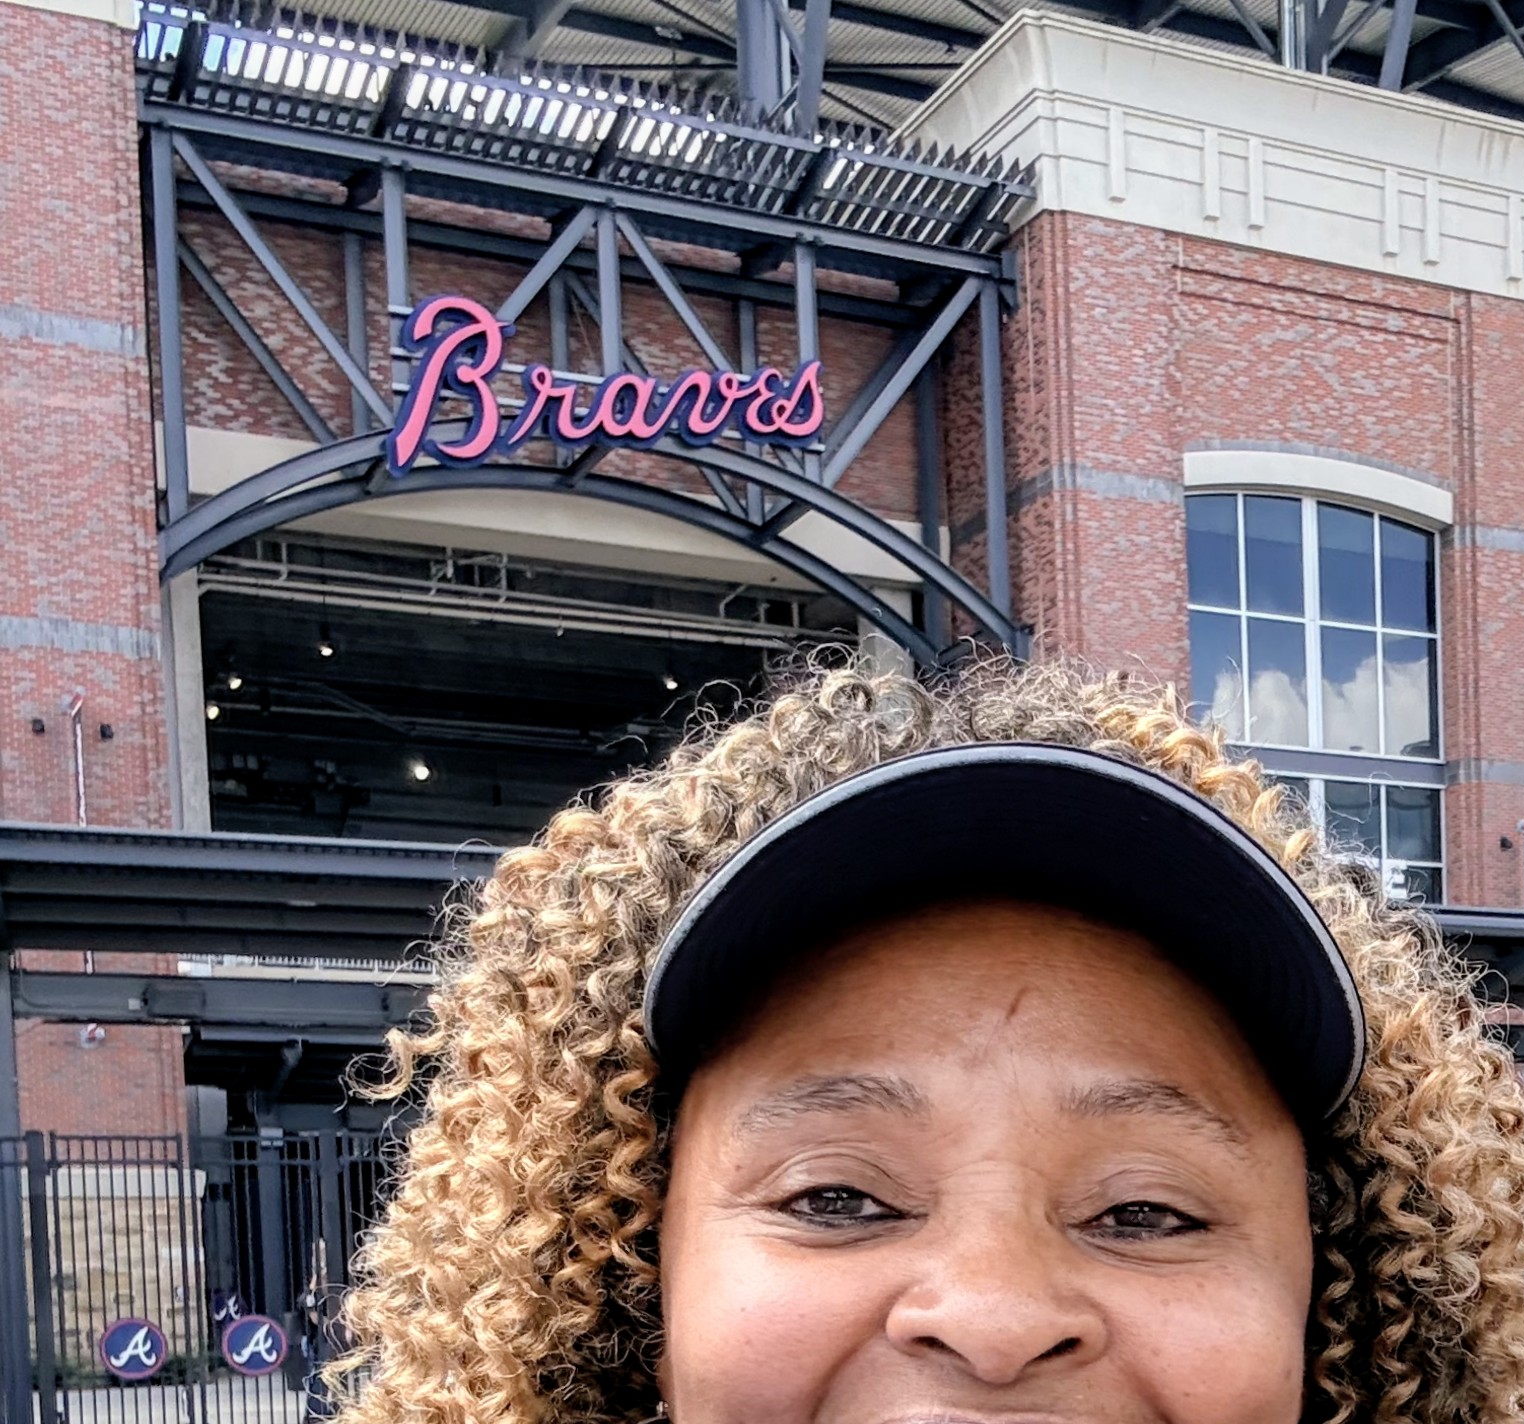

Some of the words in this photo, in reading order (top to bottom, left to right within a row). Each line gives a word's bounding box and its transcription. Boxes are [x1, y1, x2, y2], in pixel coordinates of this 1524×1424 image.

[389, 294, 825, 474] Braves
[110, 1325, 157, 1368] A
[232, 1322, 277, 1365] A
